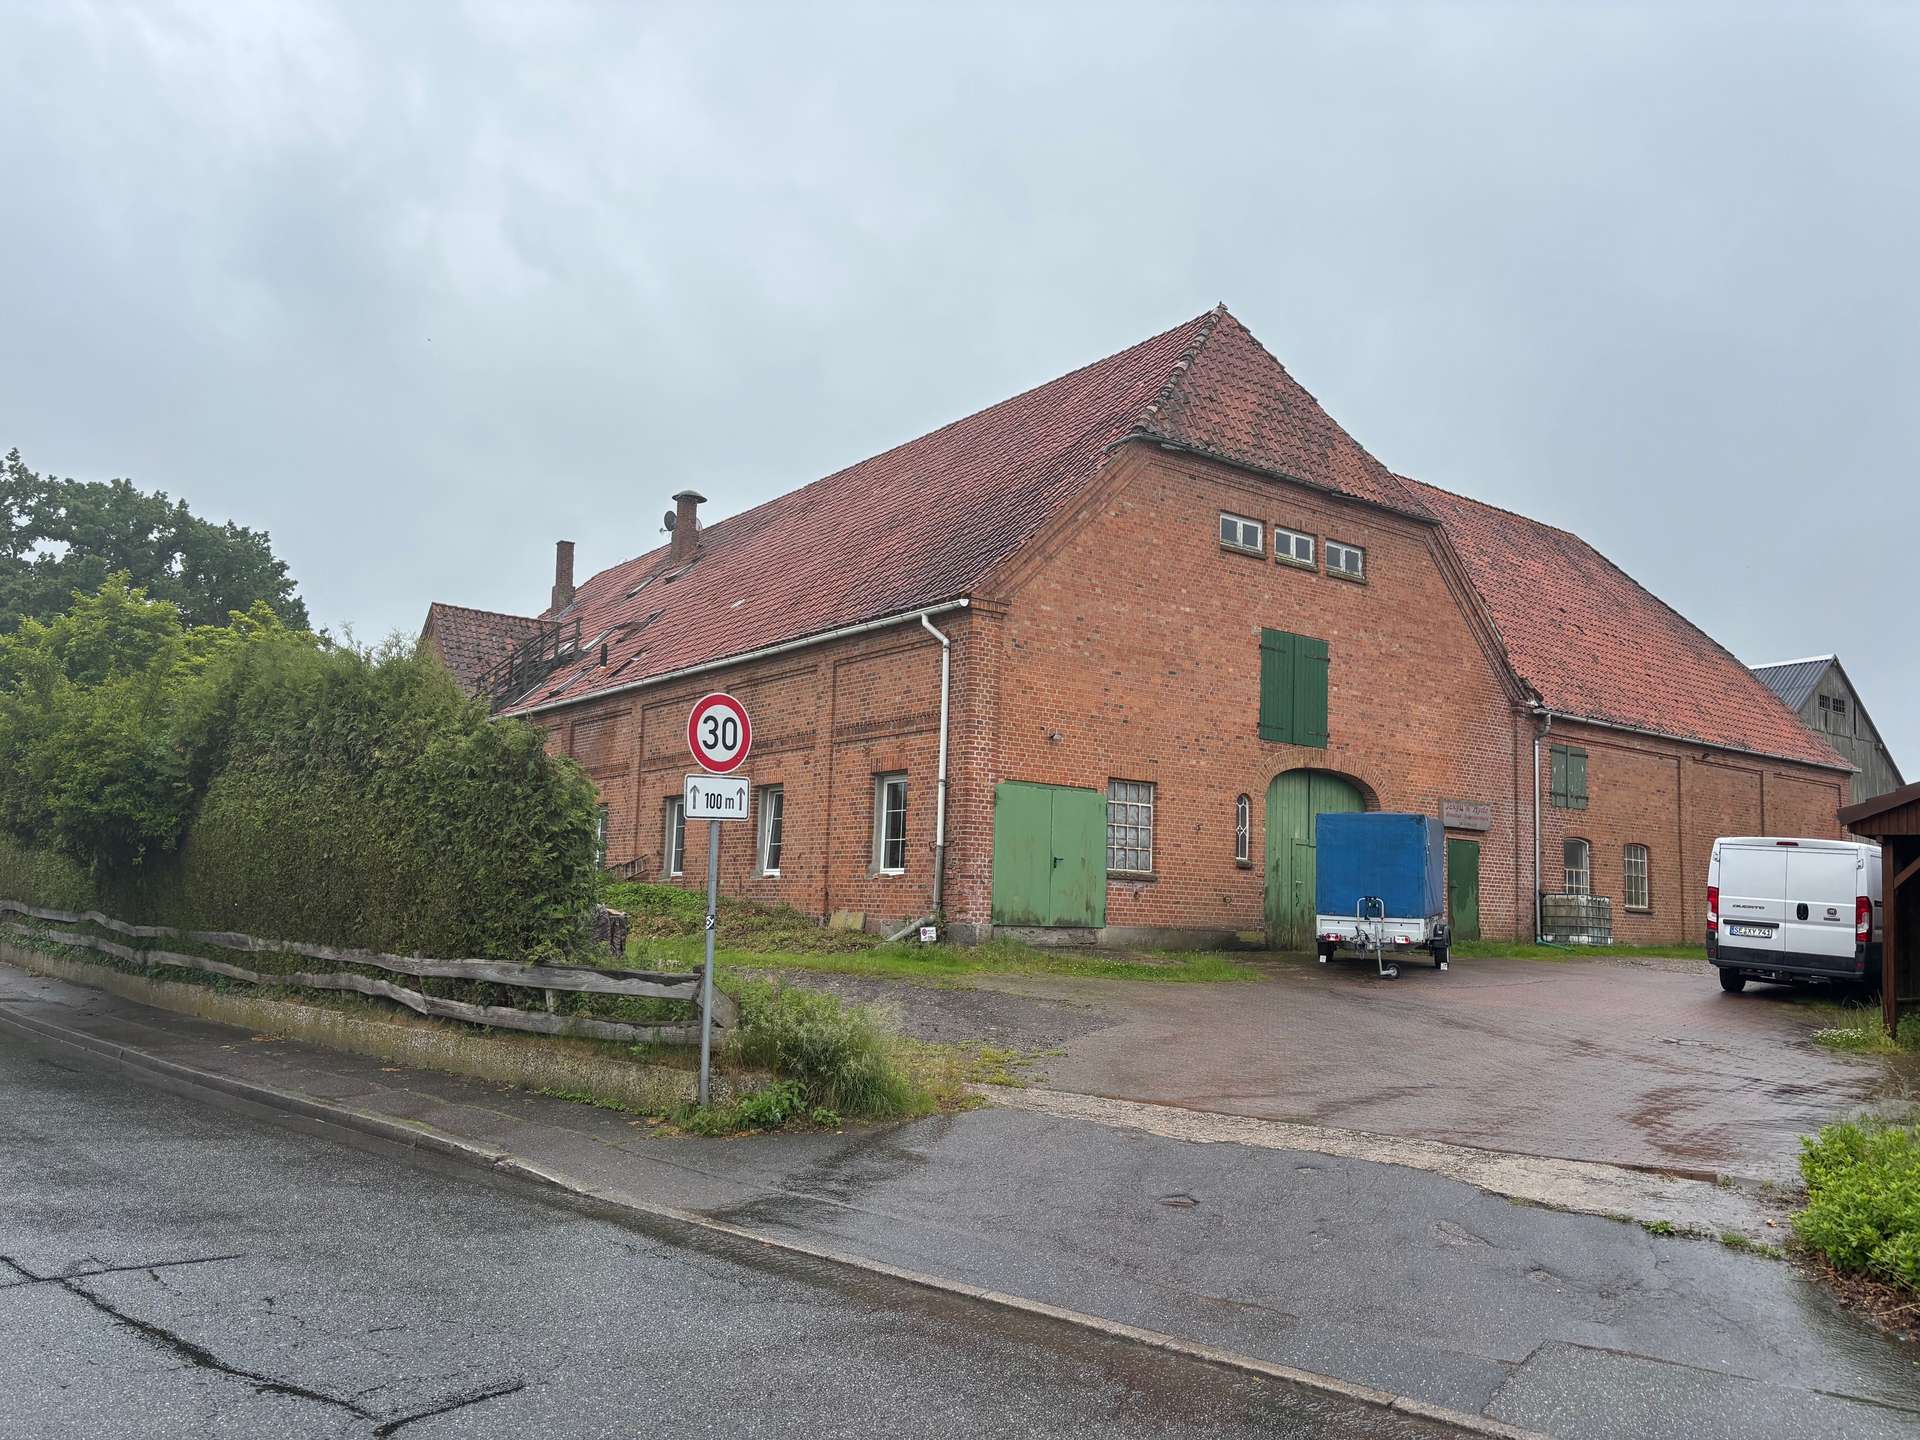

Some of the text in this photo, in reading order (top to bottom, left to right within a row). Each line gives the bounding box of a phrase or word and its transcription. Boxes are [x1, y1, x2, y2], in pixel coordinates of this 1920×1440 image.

[702, 715, 738, 751] 30
[704, 792, 735, 810] 100 m
